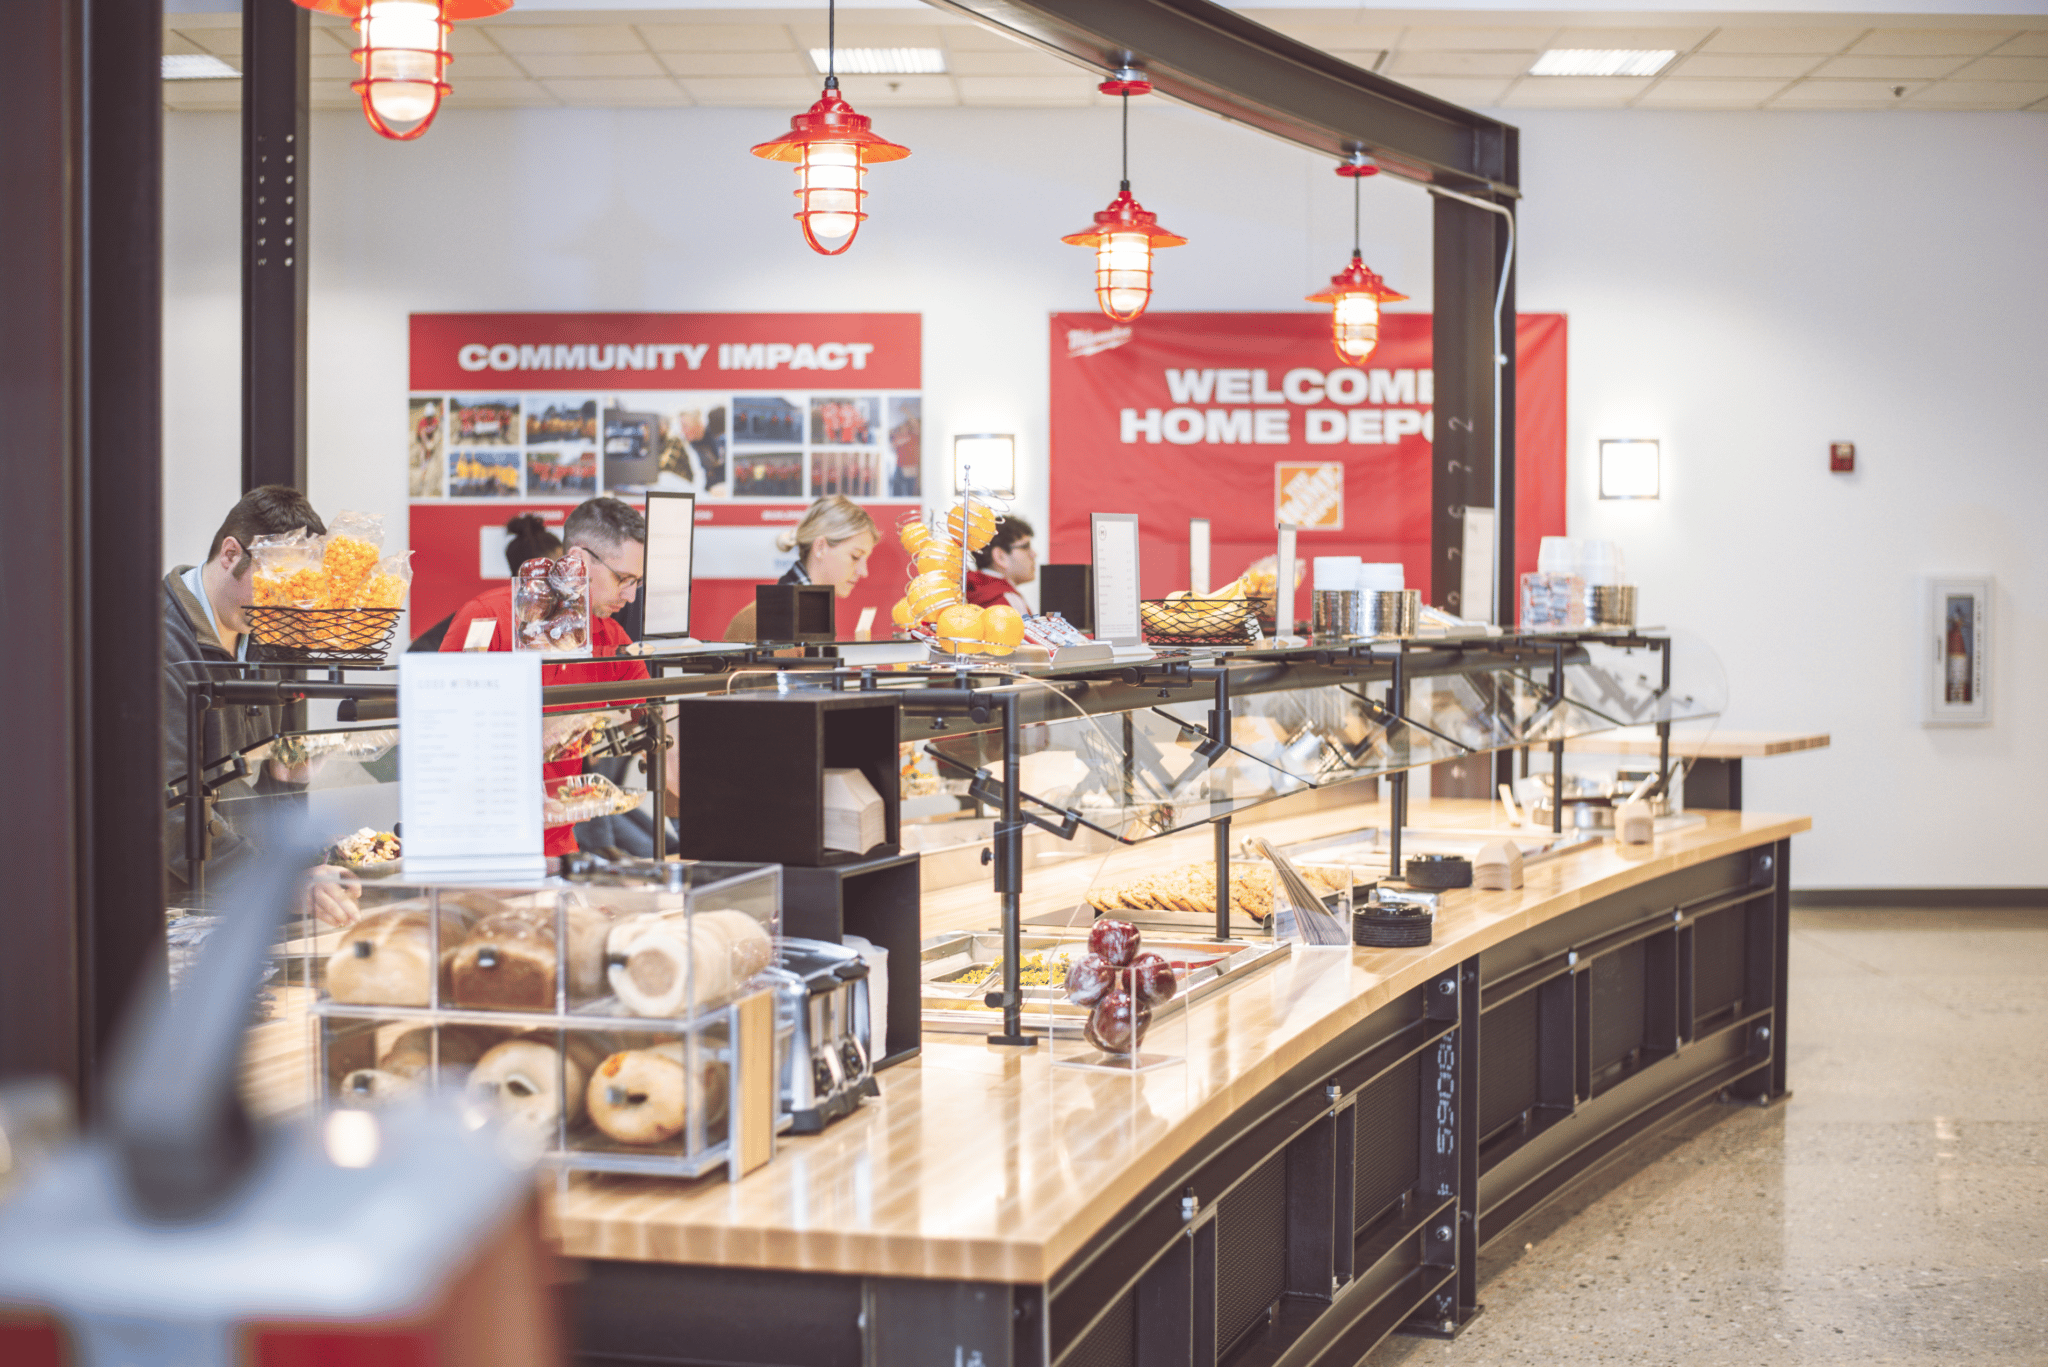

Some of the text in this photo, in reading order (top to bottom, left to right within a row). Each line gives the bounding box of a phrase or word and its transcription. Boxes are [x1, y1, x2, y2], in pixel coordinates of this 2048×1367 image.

[458, 343, 874, 372] COMMUNITY IMPACT
[1120, 407, 1434, 445] HOME DEP
